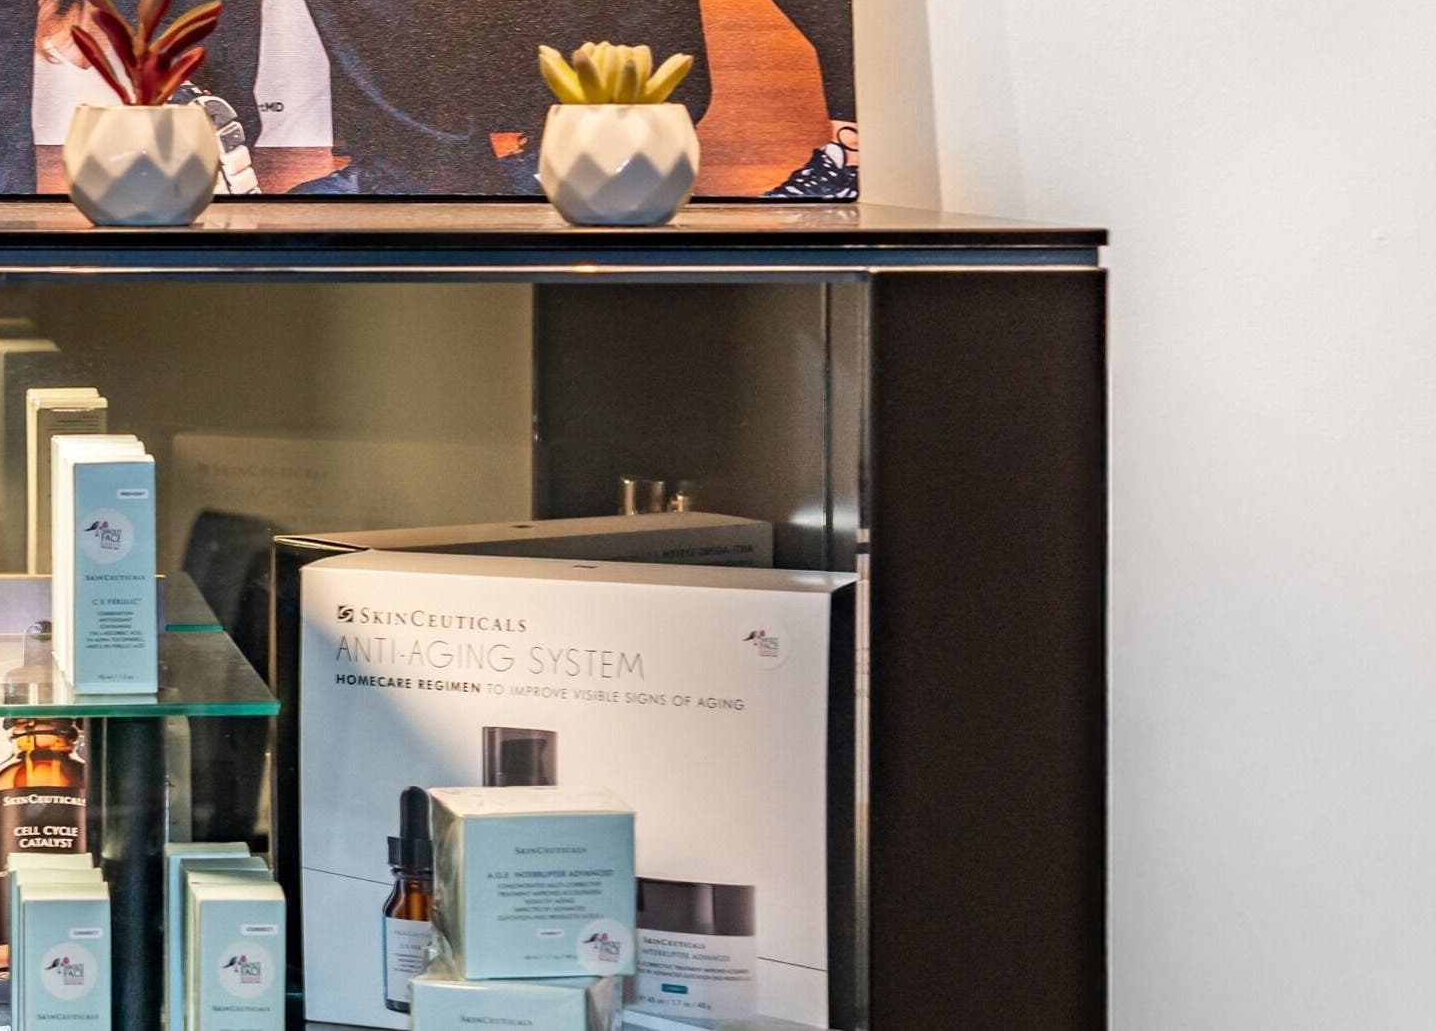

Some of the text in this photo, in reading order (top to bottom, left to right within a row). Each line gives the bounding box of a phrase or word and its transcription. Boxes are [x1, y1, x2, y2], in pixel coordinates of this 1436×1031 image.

[359, 607, 527, 633] SKINCEUTICALS
[336, 634, 645, 681] ANTI-AGING SYSTEM
[336, 673, 745, 710] HOMECARE REGIMEN TO IMPROVE VISIBLE SIGNS OF AGING
[14, 826, 79, 837] CELL CYCLE
[19, 838, 74, 848] CATALYST
